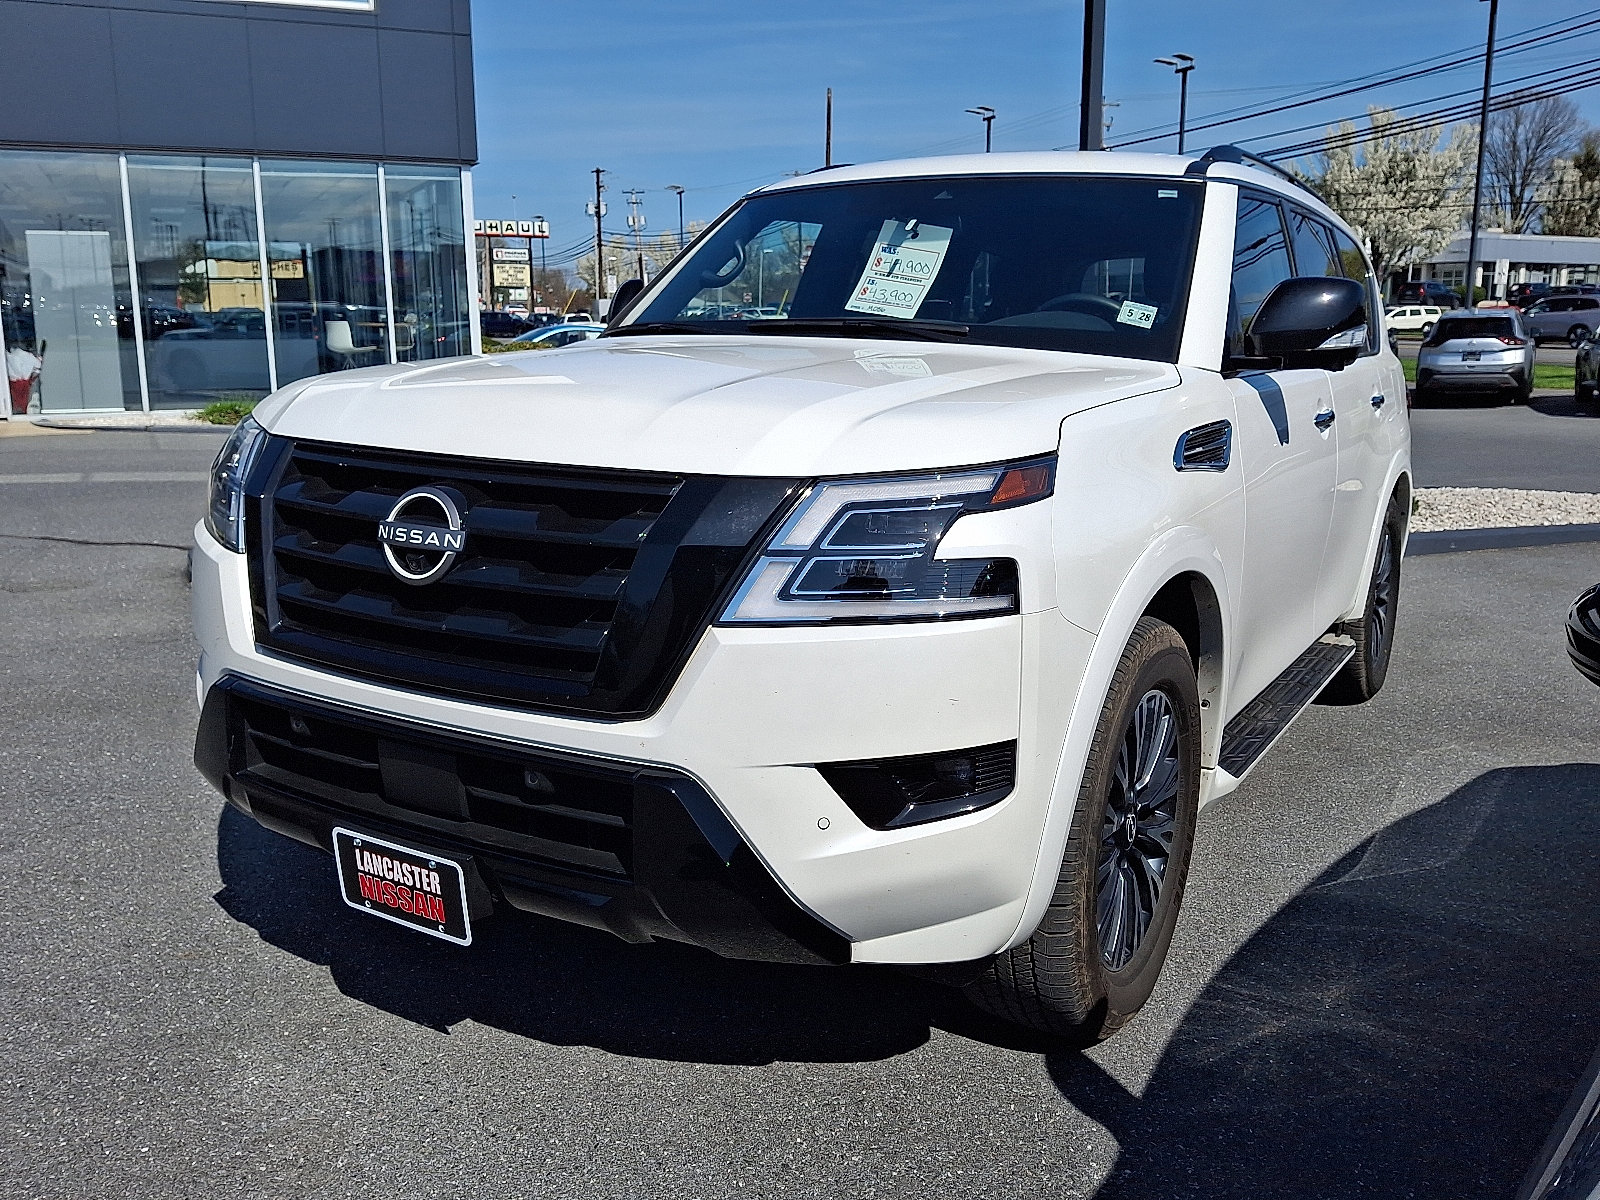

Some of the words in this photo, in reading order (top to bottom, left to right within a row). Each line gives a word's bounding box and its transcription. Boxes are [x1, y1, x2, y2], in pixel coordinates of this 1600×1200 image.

[1126, 308, 1135, 318] 5
[1138, 312, 1152, 322] 28
[377, 524, 461, 549] NISSAN
[354, 848, 442, 896] LANCASTER
[358, 873, 446, 924] NISSAN
